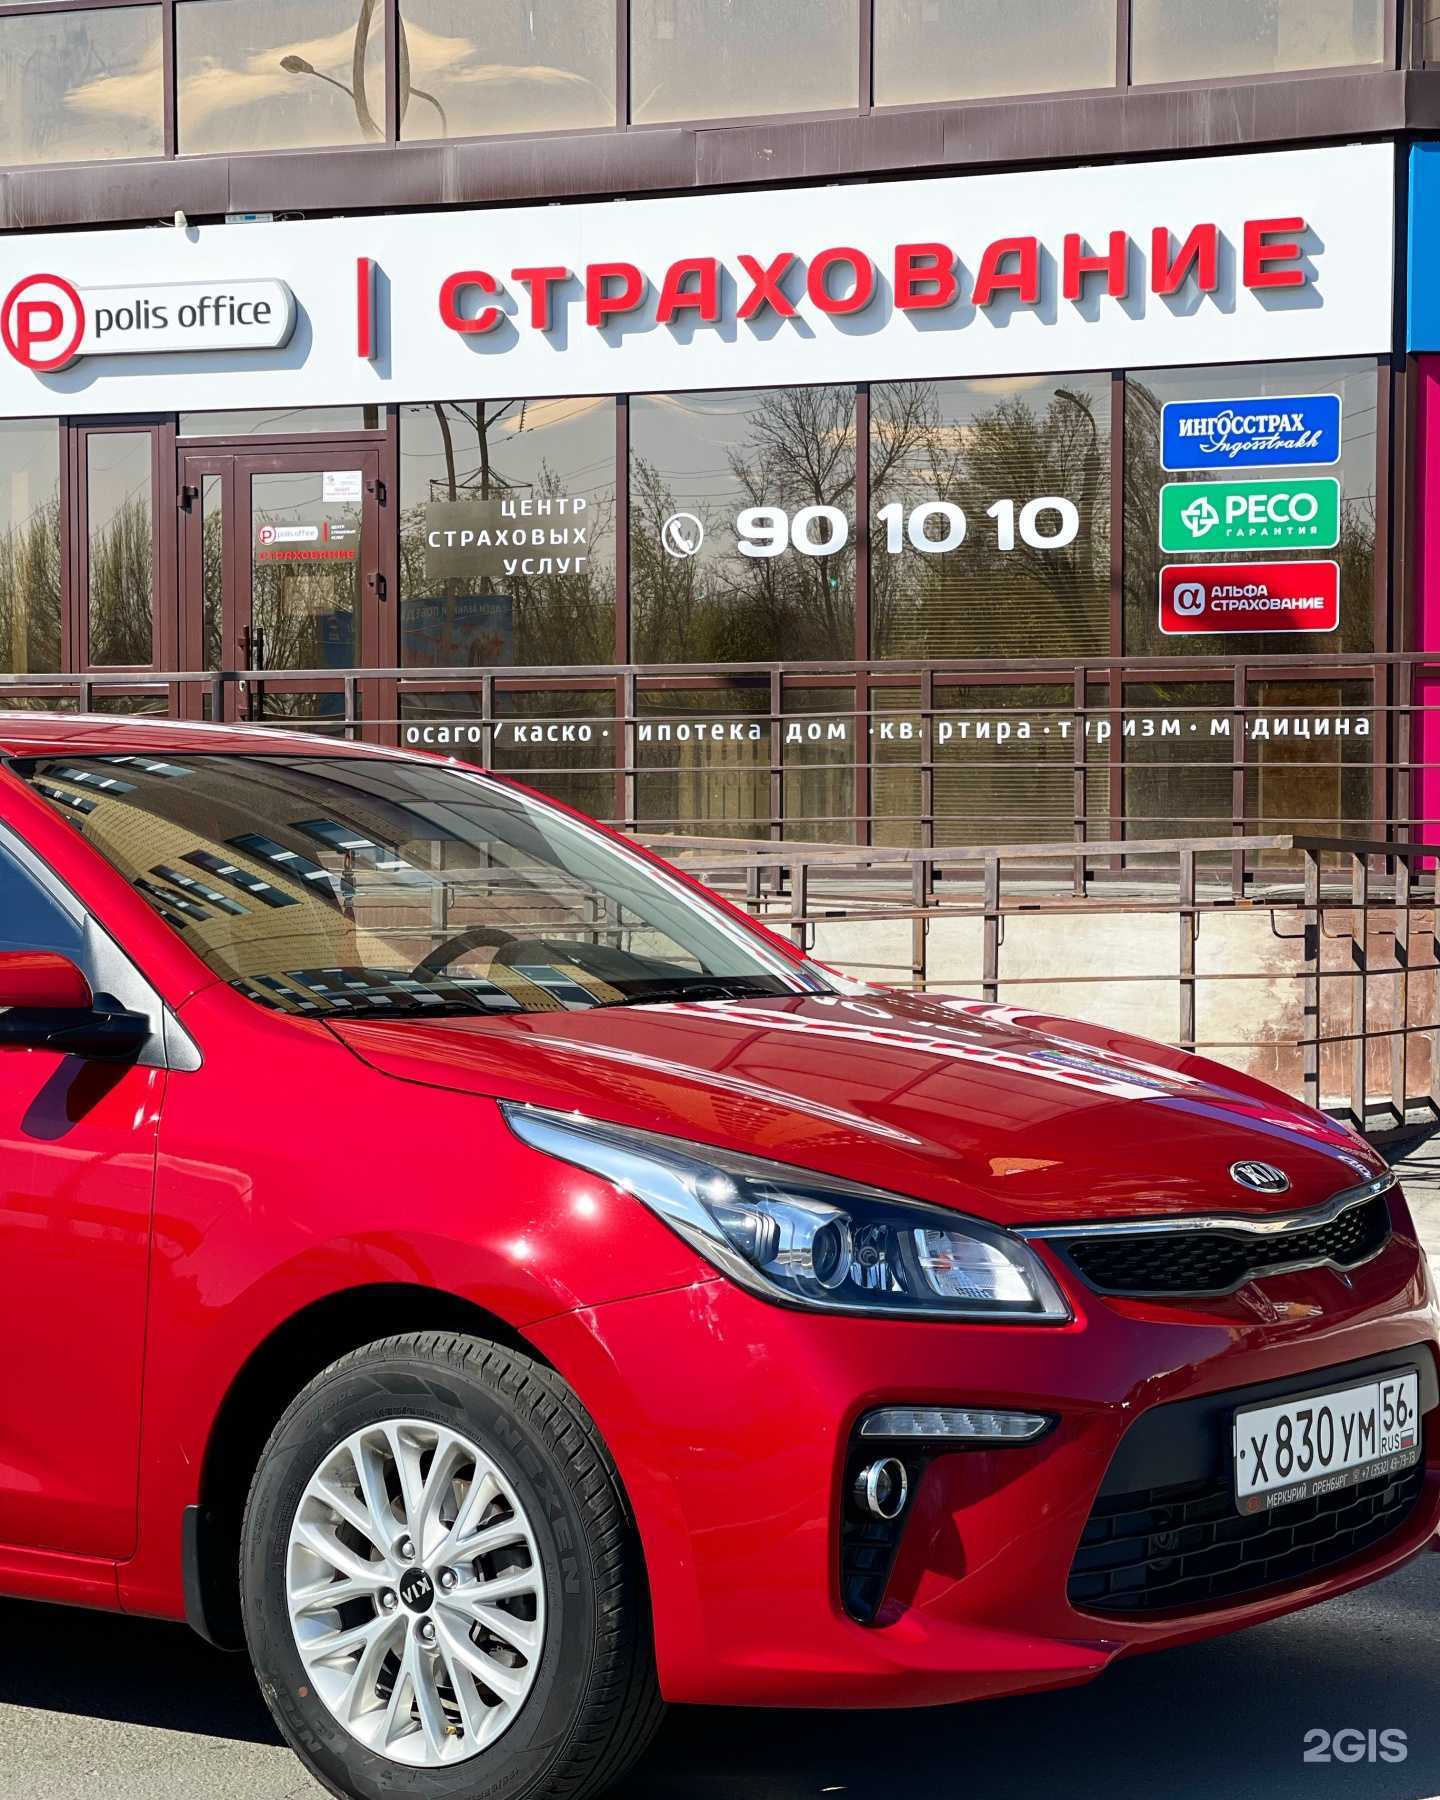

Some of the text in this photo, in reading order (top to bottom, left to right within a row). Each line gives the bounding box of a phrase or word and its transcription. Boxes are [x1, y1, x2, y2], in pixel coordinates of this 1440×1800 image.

[439, 217, 1308, 334] СТРАХОВАНИЕ
[95, 299, 168, 338] polis
[178, 295, 271, 328] office
[1178, 410, 1305, 437] ИНГОССТРАХ
[1200, 430, 1323, 458] Ingosstrakh
[501, 498, 587, 518] ЦЕНТР
[1225, 493, 1318, 524] РЕСО
[428, 528, 587, 548] СТРАХОВЫХ
[736, 496, 1080, 557] 90 10 10
[1226, 526, 1318, 537] ГАРАНТИЯ
[503, 556, 587, 575] УСЛУГ
[1211, 584, 1268, 598] АЛЬФА
[1211, 597, 1325, 611] СТРАХОВАНИЕ
[406, 725, 481, 743] осаго
[514, 724, 592, 742] каско
[638, 722, 761, 741] ипотека
[785, 722, 846, 744] дом
[880, 720, 1031, 744] квртира
[1058, 719, 1181, 743] тризм
[1210, 717, 1370, 739] мдицина
[1383, 1383, 1408, 1432] 56
[1381, 1434, 1400, 1454] RUS
[1266, 1486, 1308, 1508] МЕРКУРИЙ
[1312, 1474, 1349, 1496] ОРЕНБУРГ
[401, 1576, 432, 1604] KIA
